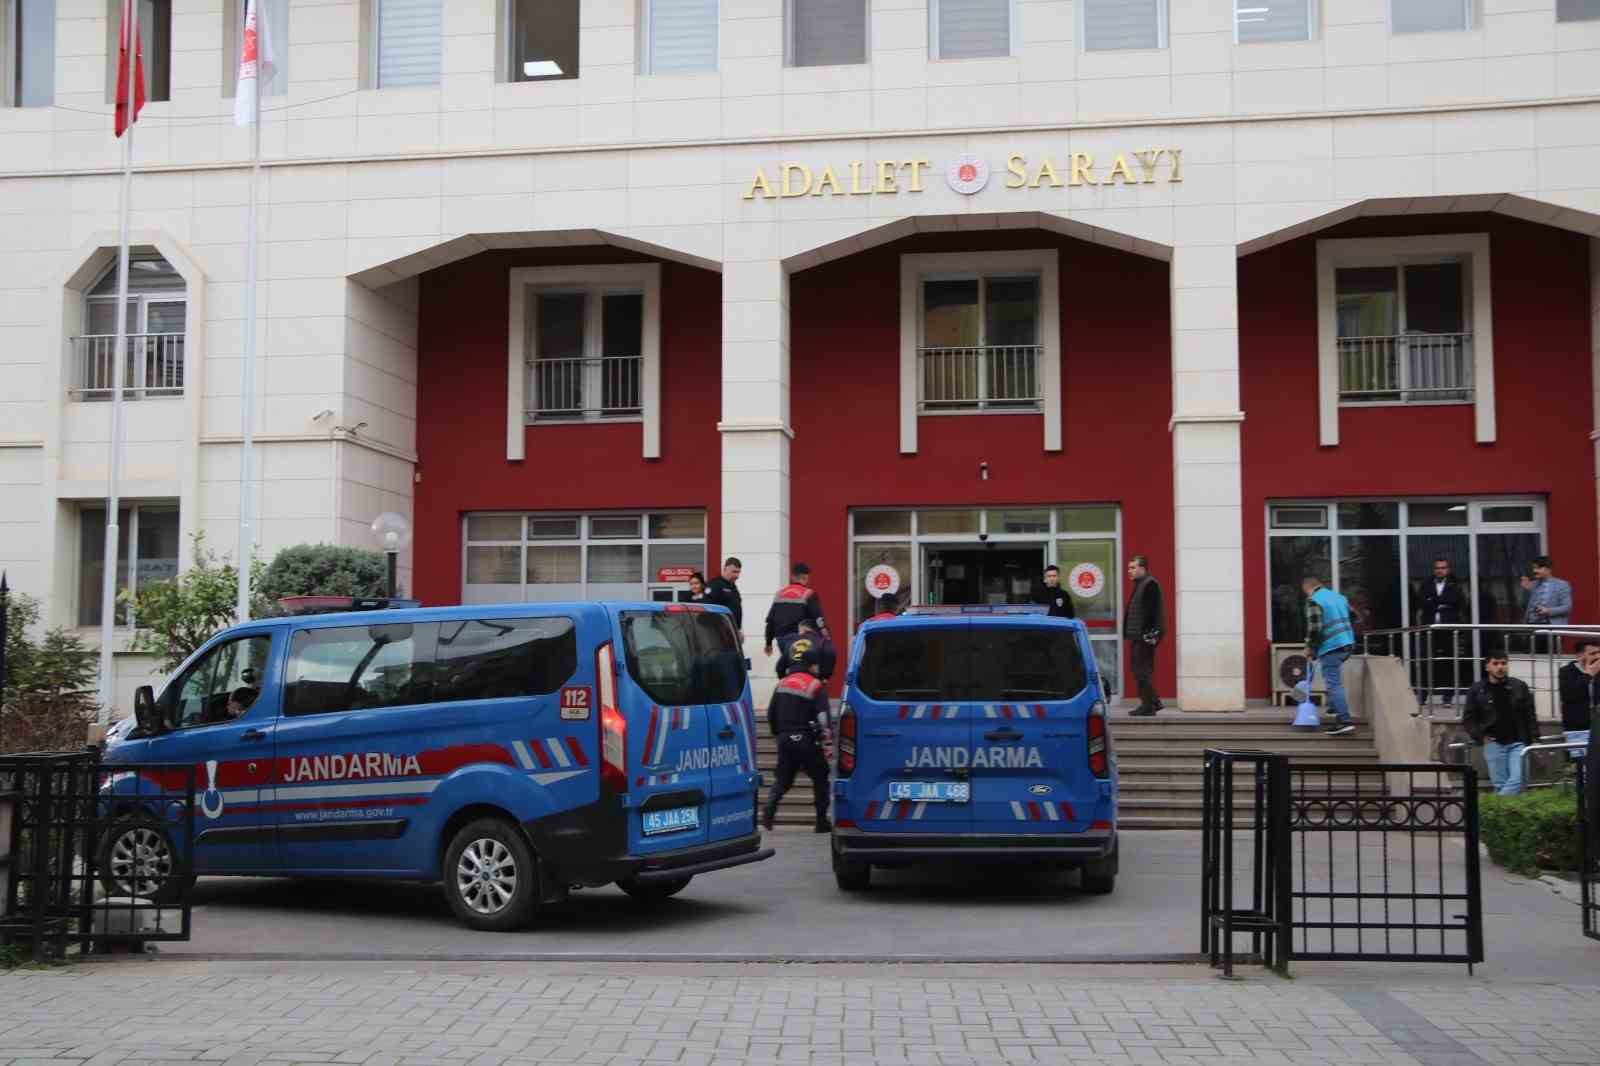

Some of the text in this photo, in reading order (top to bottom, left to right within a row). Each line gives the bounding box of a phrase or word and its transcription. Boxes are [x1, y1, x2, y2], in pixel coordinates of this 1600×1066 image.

[743, 147, 1183, 200] ADALET SARAYI
[564, 689, 587, 706] 112
[284, 752, 422, 782] JANDARMA
[676, 743, 741, 772] JANDARMA
[905, 746, 1043, 768] JANDARMA
[648, 811, 662, 827] 45
